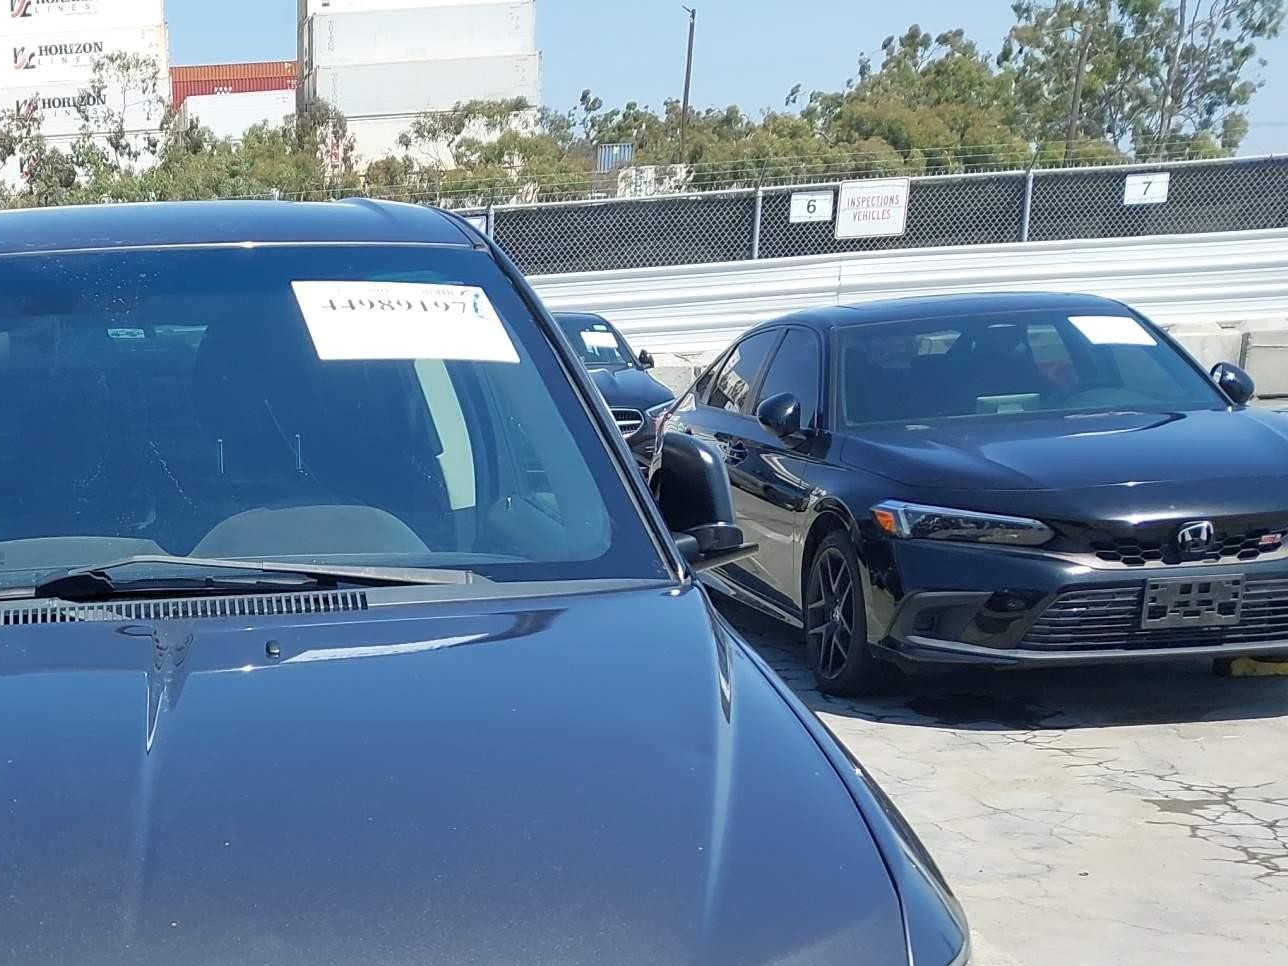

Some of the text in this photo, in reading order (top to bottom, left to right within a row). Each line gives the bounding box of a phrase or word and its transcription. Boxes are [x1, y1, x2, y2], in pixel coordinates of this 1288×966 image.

[37, 41, 104, 56] HORIZON
[1143, 180, 1153, 195] 7
[806, 199, 817, 214] 6
[847, 194, 900, 209] INSPECTIONS
[852, 209, 891, 222] VEHICLES
